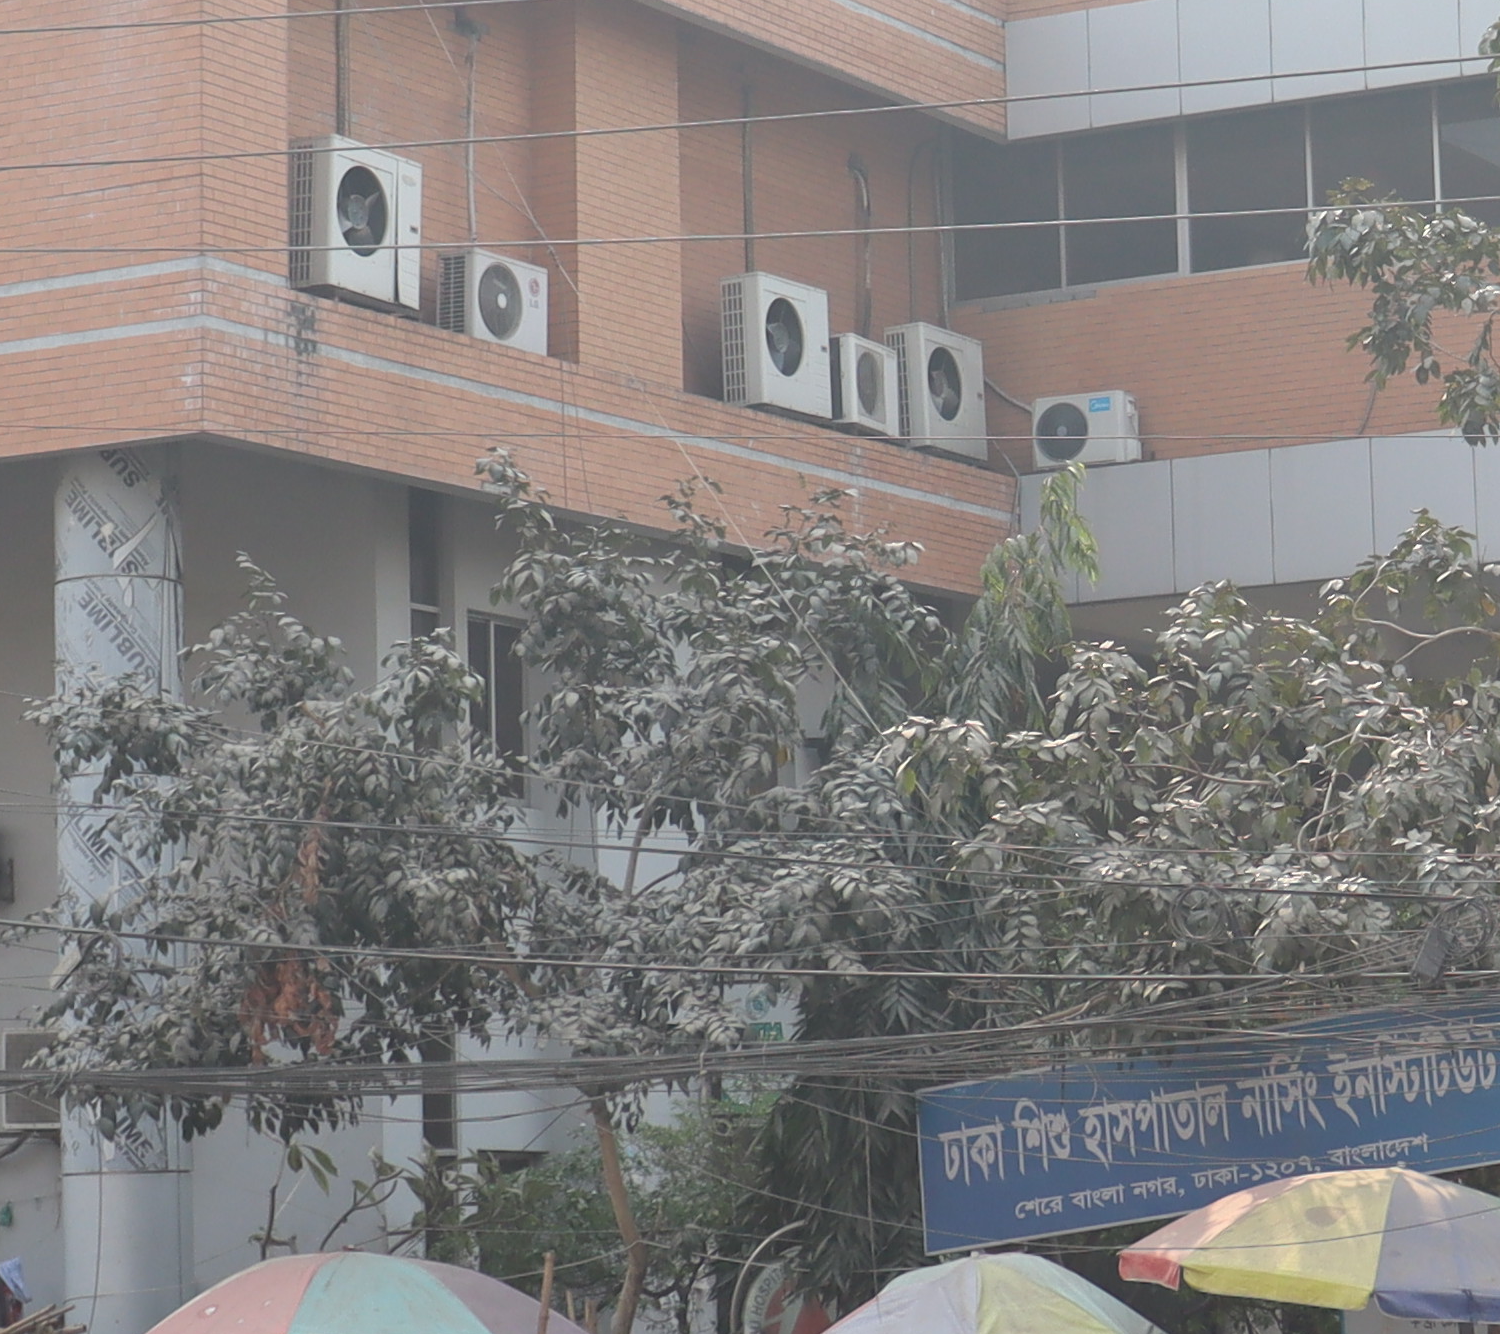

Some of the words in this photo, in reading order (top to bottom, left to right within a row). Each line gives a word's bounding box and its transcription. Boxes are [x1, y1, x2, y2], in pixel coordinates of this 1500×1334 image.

[937, 1115, 1005, 1187] ঢাকা
[1011, 1096, 1071, 1175] শিশু
[1079, 1081, 1230, 1171] হাসপাতাল
[1015, 1196, 1063, 1219] শেরে
[1069, 1184, 1125, 1212] বাংলা
[1130, 1176, 1186, 1199] নগর,
[1327, 1133, 1430, 1165] বাংলাদেশ
